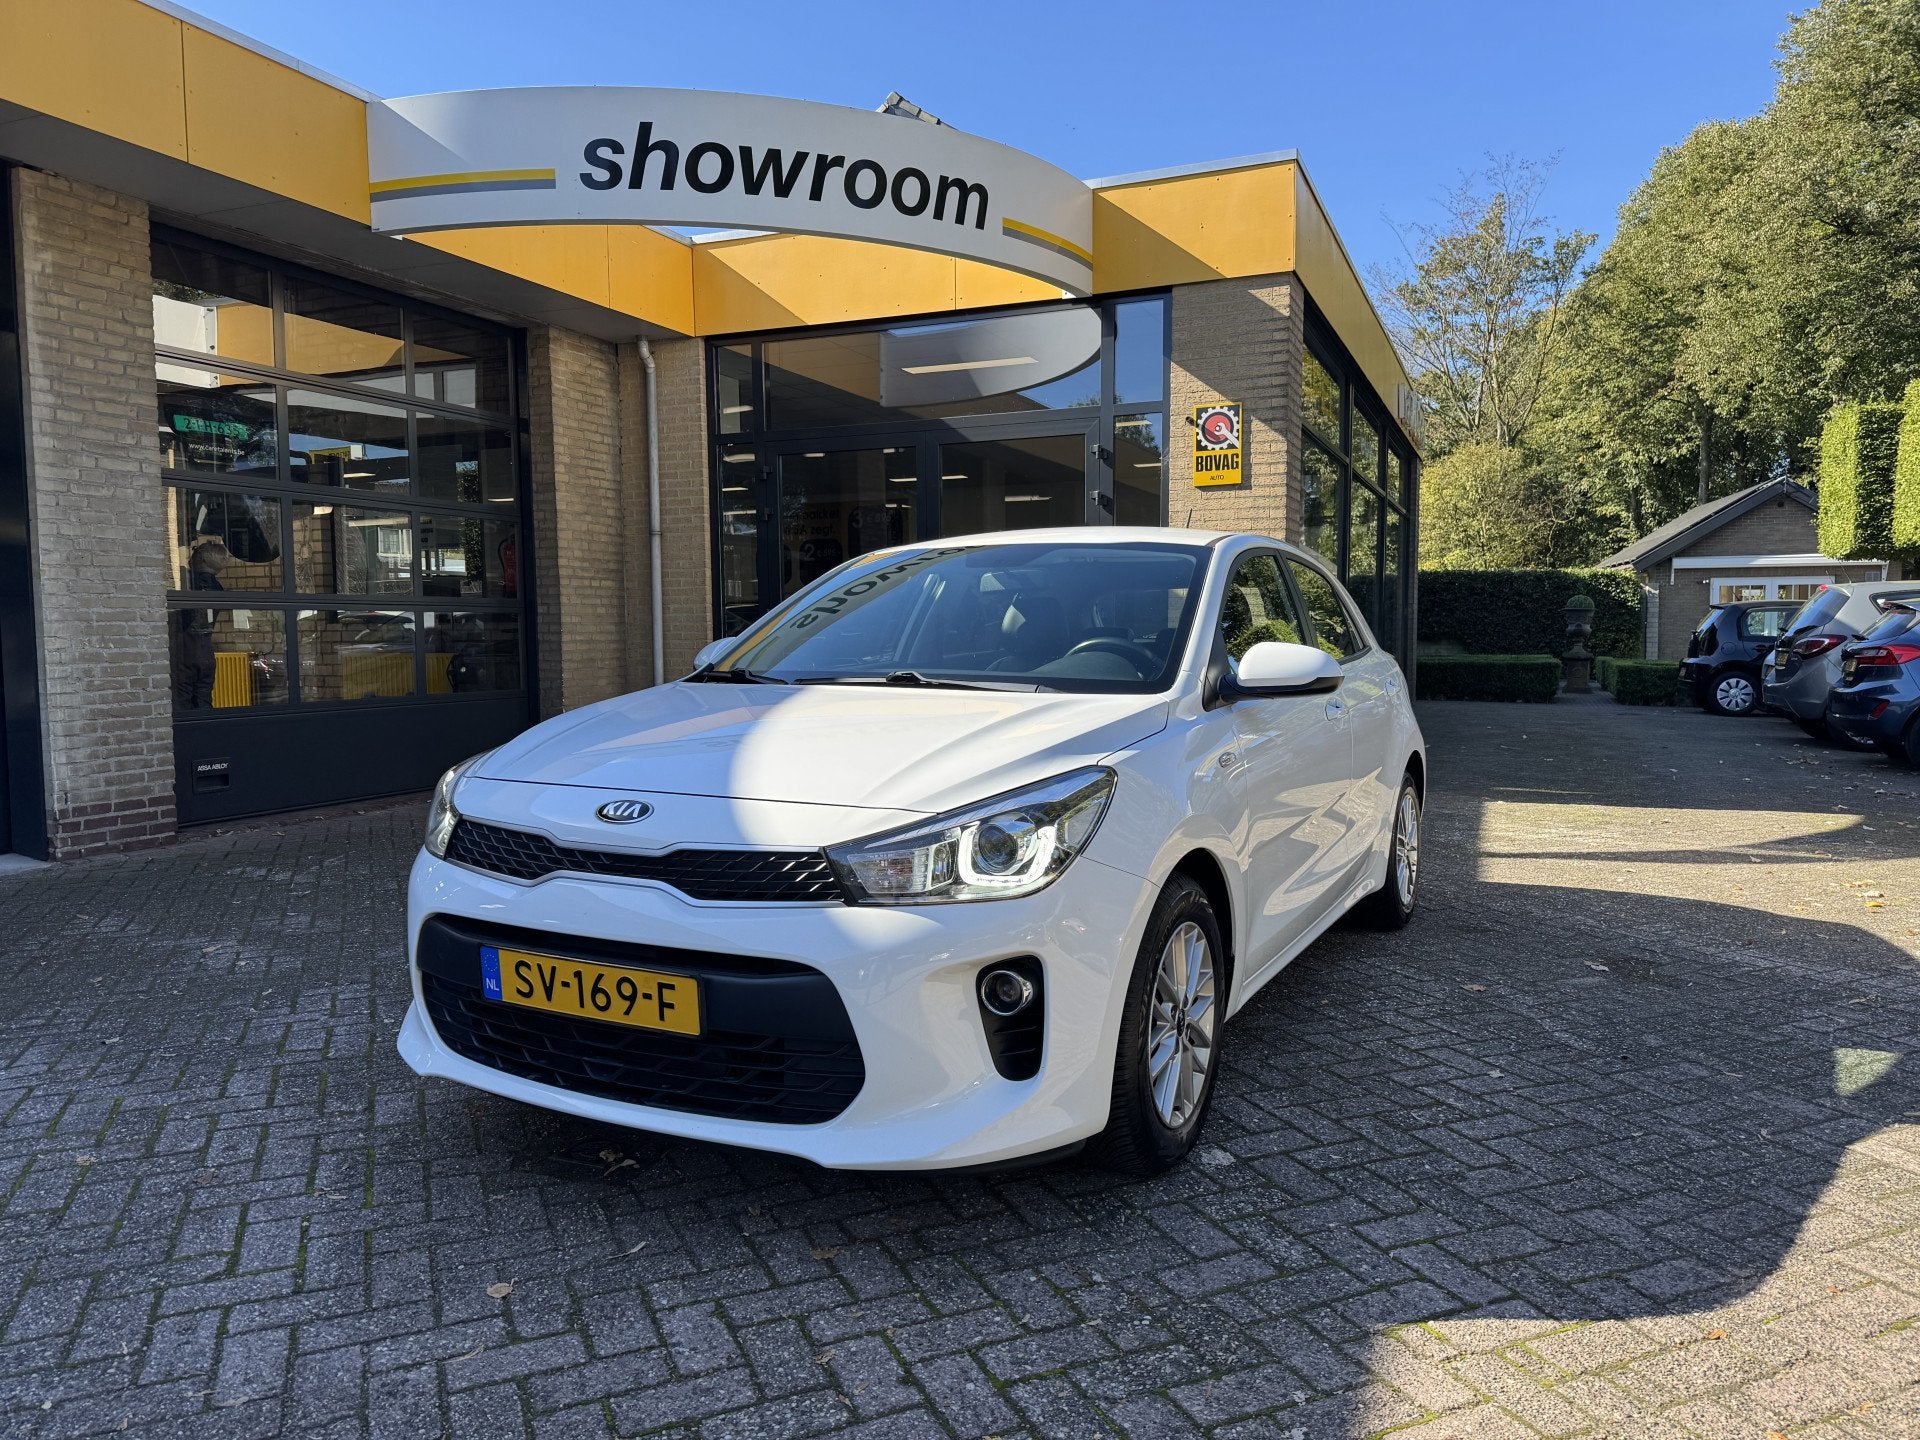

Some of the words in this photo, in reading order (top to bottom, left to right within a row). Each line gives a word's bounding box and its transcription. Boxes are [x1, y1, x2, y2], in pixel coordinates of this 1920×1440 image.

[579, 121, 989, 230] showroom
[1196, 453, 1239, 472] BOVAG
[601, 801, 642, 818] KIA
[485, 977, 500, 991] NL
[514, 959, 676, 1022] SV-169-F
